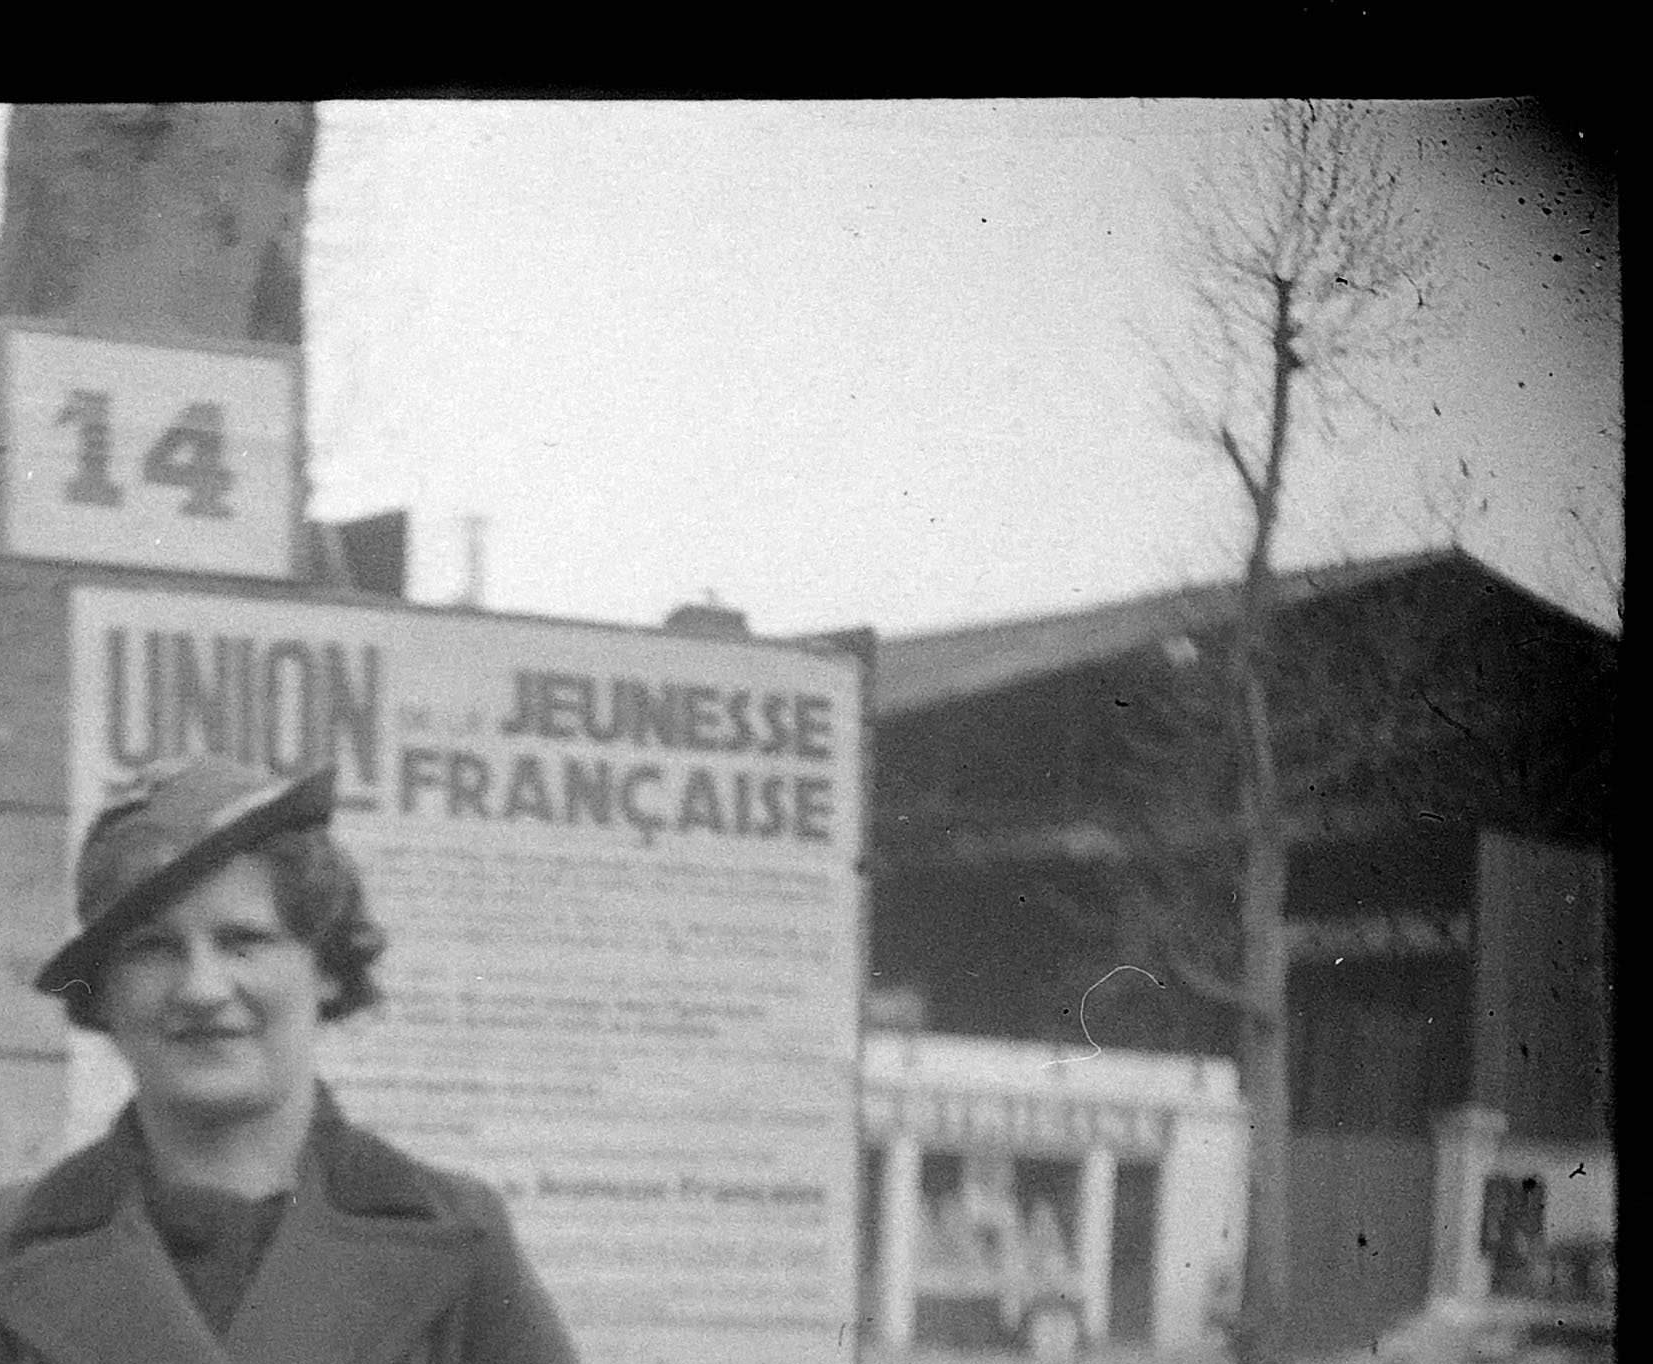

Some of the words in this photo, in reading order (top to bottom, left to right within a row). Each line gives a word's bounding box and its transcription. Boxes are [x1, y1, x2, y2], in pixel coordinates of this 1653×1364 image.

[55, 388, 237, 519] 14
[106, 626, 381, 787] UNION
[501, 669, 834, 760] JEUNESSE
[396, 745, 835, 844] FRANÇAISE
